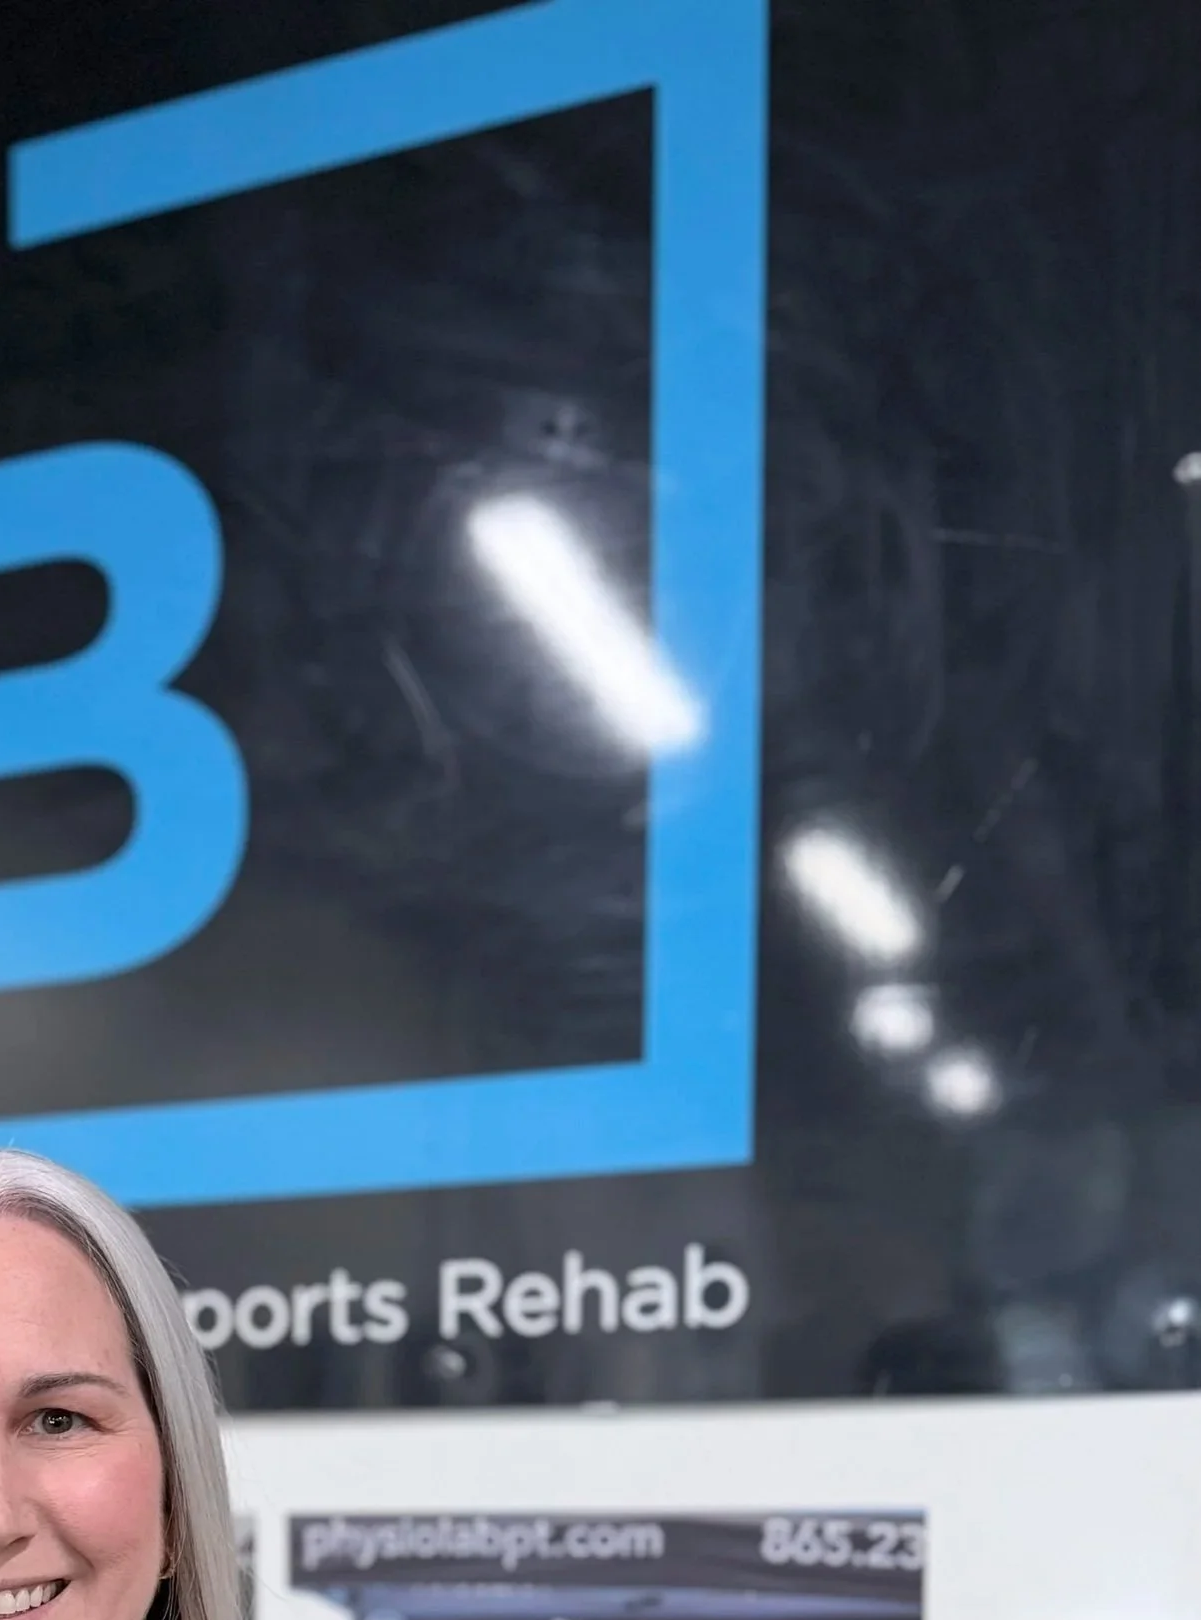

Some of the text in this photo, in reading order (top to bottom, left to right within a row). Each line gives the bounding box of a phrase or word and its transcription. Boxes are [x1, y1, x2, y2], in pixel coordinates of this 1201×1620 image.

[182, 1267, 410, 1350] ports
[439, 1242, 750, 1339] Rehab
[302, 1515, 665, 1571] physiolabpt.com
